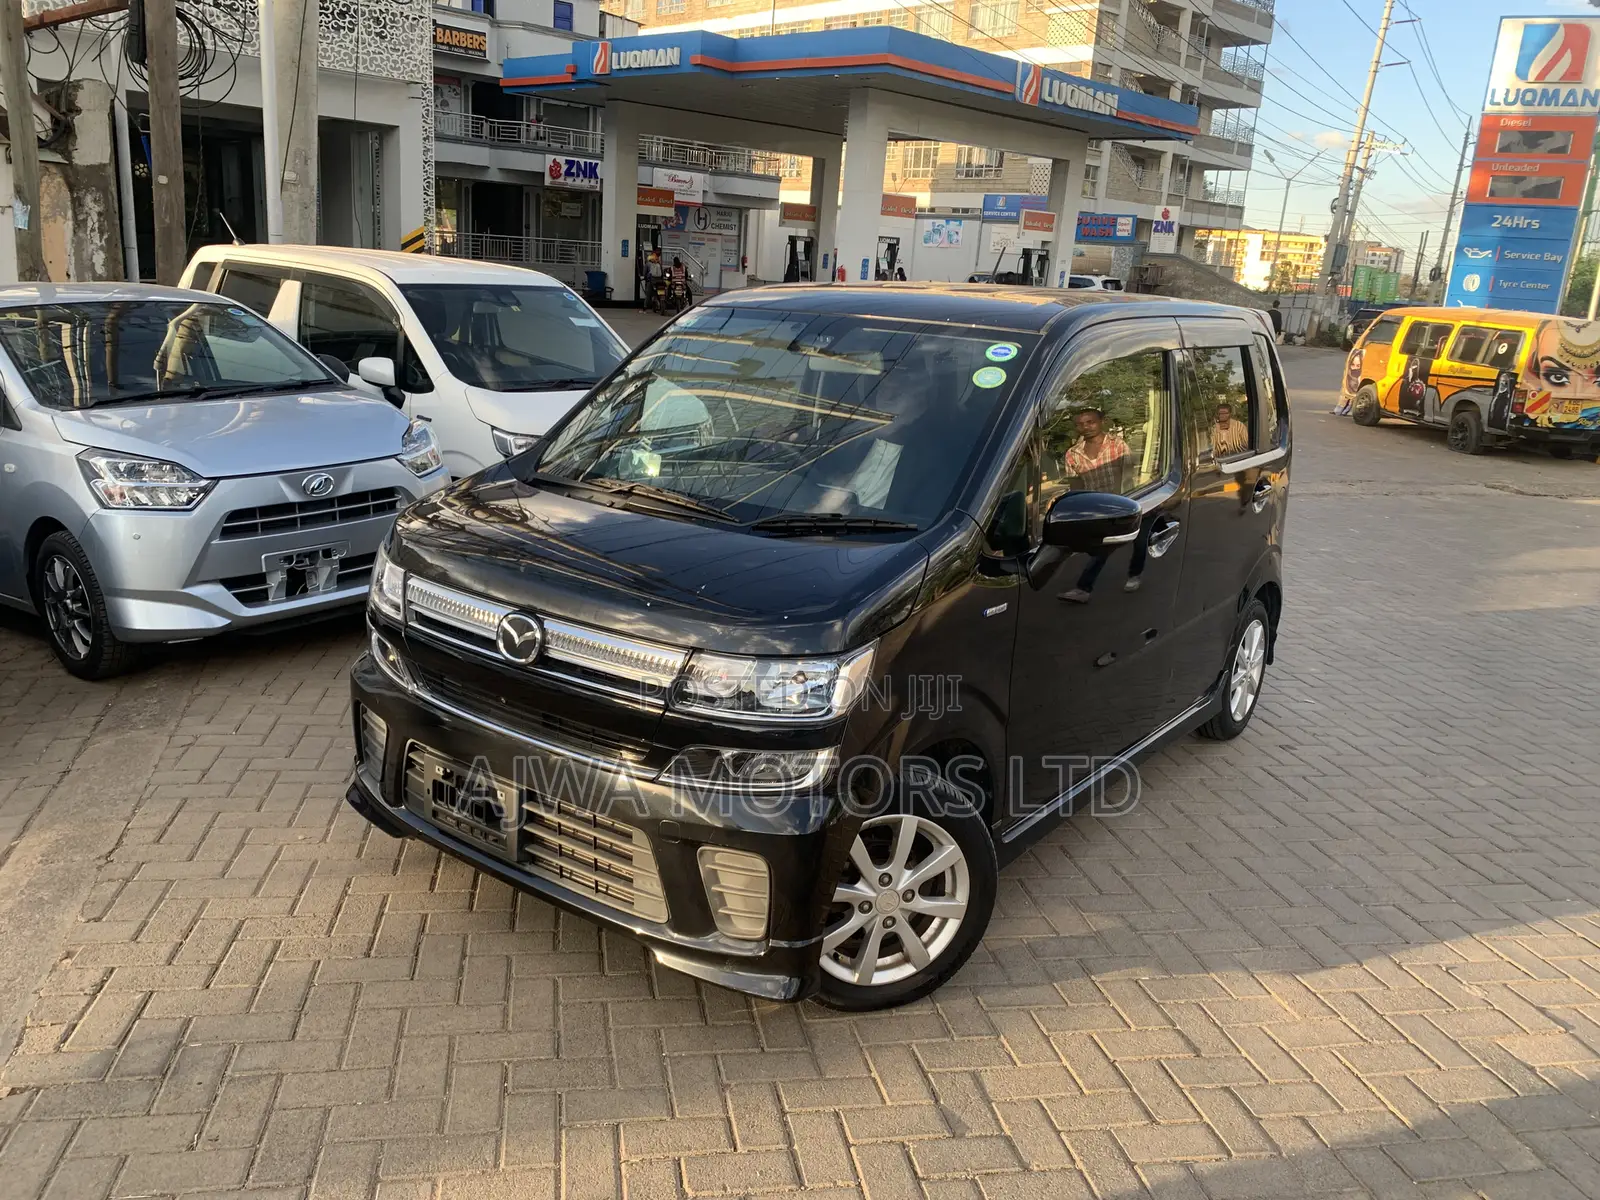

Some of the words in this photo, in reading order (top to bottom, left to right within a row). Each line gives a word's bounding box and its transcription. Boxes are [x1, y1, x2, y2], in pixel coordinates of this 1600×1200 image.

[436, 28, 486, 50] BARBERS
[612, 47, 680, 69] LUQMAN
[1042, 78, 1118, 116] LUQMAN
[1489, 88, 1600, 107] LUQMAN
[1500, 118, 1532, 127] Diesel
[563, 159, 600, 179] ZNK
[1491, 163, 1540, 172] Unleaded
[711, 222, 736, 230] CHEMIST
[1152, 220, 1175, 233] ZNK
[1491, 214, 1541, 229] 24Hrs
[1081, 227, 1113, 237] WASH
[1504, 250, 1541, 260] Service
[1543, 252, 1564, 263] Bay
[1499, 279, 1519, 289] Tyre
[1520, 281, 1551, 290] Center
